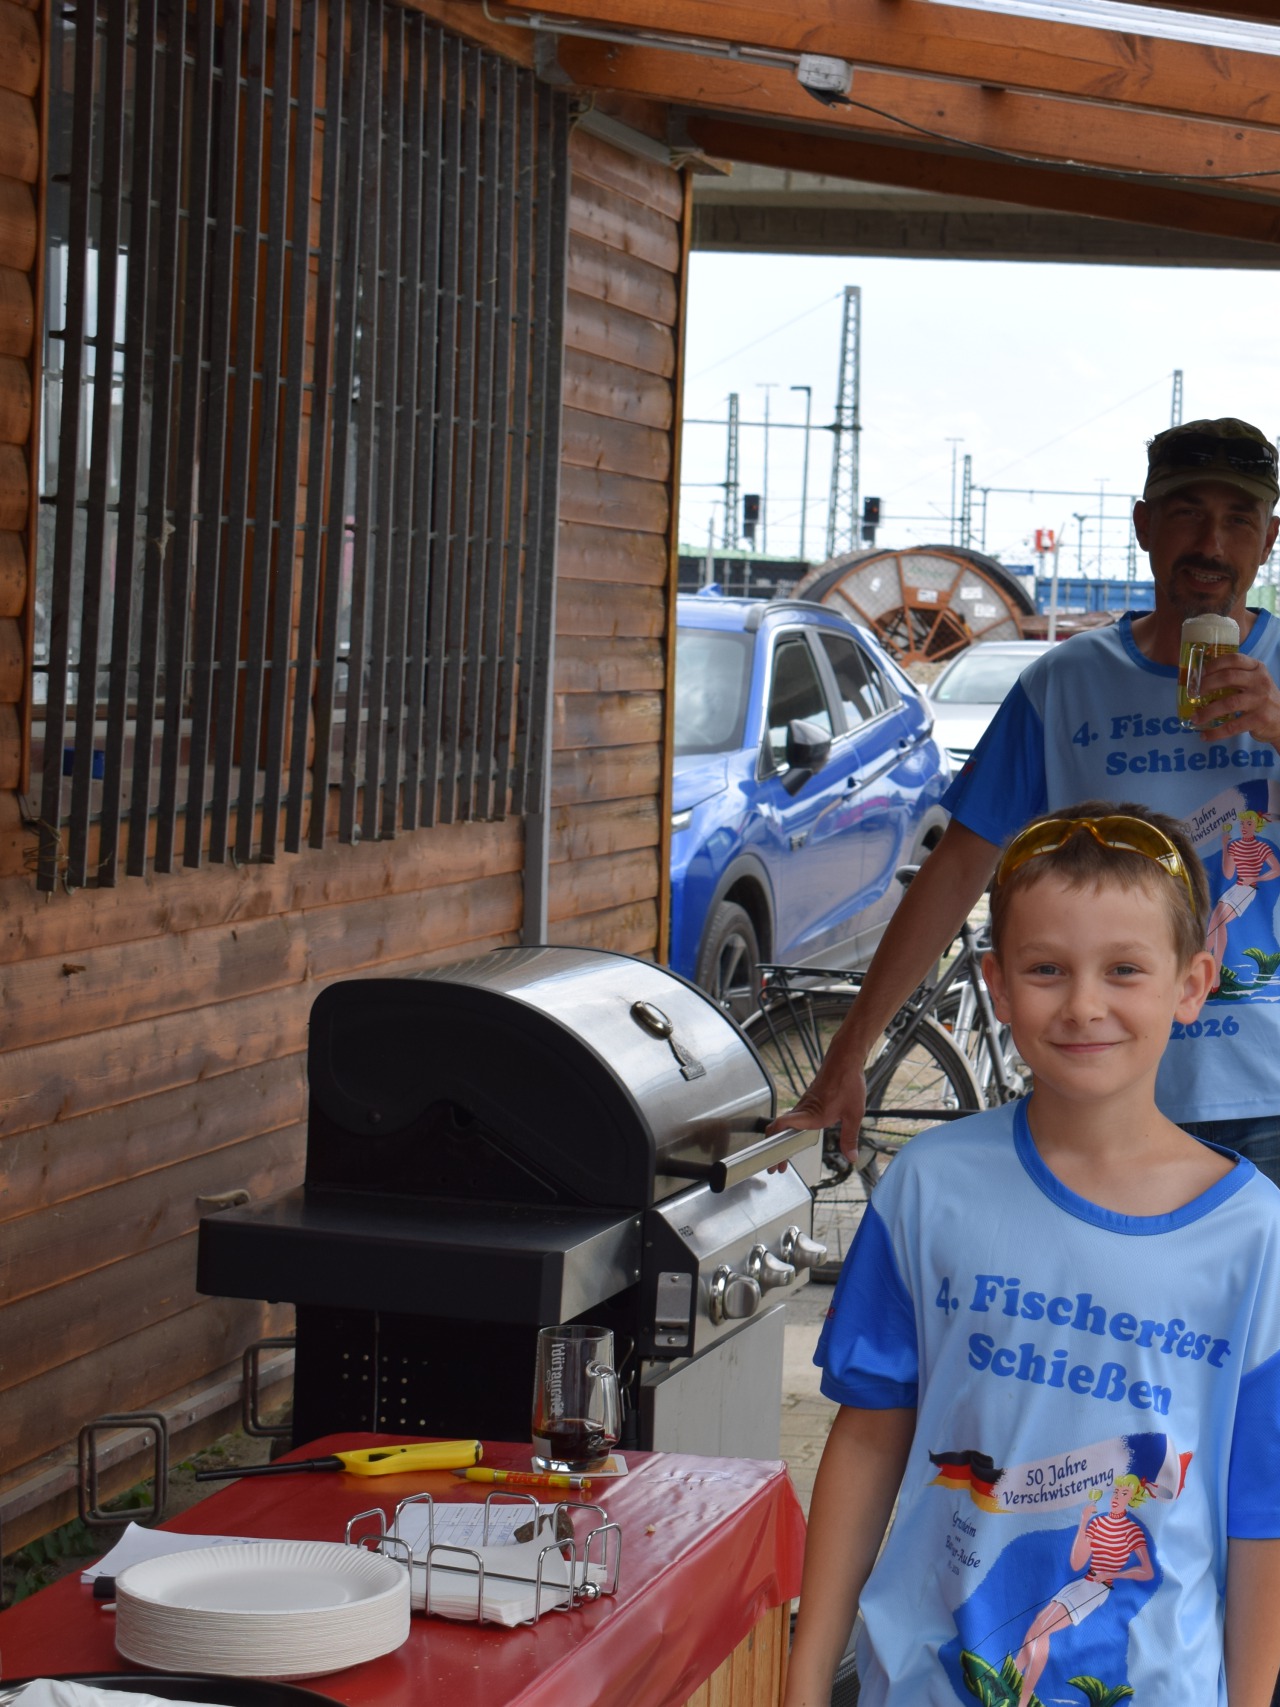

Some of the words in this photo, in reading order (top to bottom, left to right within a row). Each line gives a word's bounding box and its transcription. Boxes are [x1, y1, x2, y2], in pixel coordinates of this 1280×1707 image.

[1072, 721, 1099, 748] 4.
[1106, 744, 1275, 776] Schießen
[1190, 807, 1238, 844] hwisterung
[1192, 806, 1217, 832] Jahre
[1169, 1015, 1240, 1041] 2026
[935, 1276, 960, 1316] 4.
[969, 1274, 1233, 1369] Fischerfest
[968, 1332, 1172, 1416] Schießen
[1002, 1467, 1115, 1506] Verschwisterung
[1026, 1468, 1044, 1487] 50
[1038, 1455, 1088, 1487] Jahre
